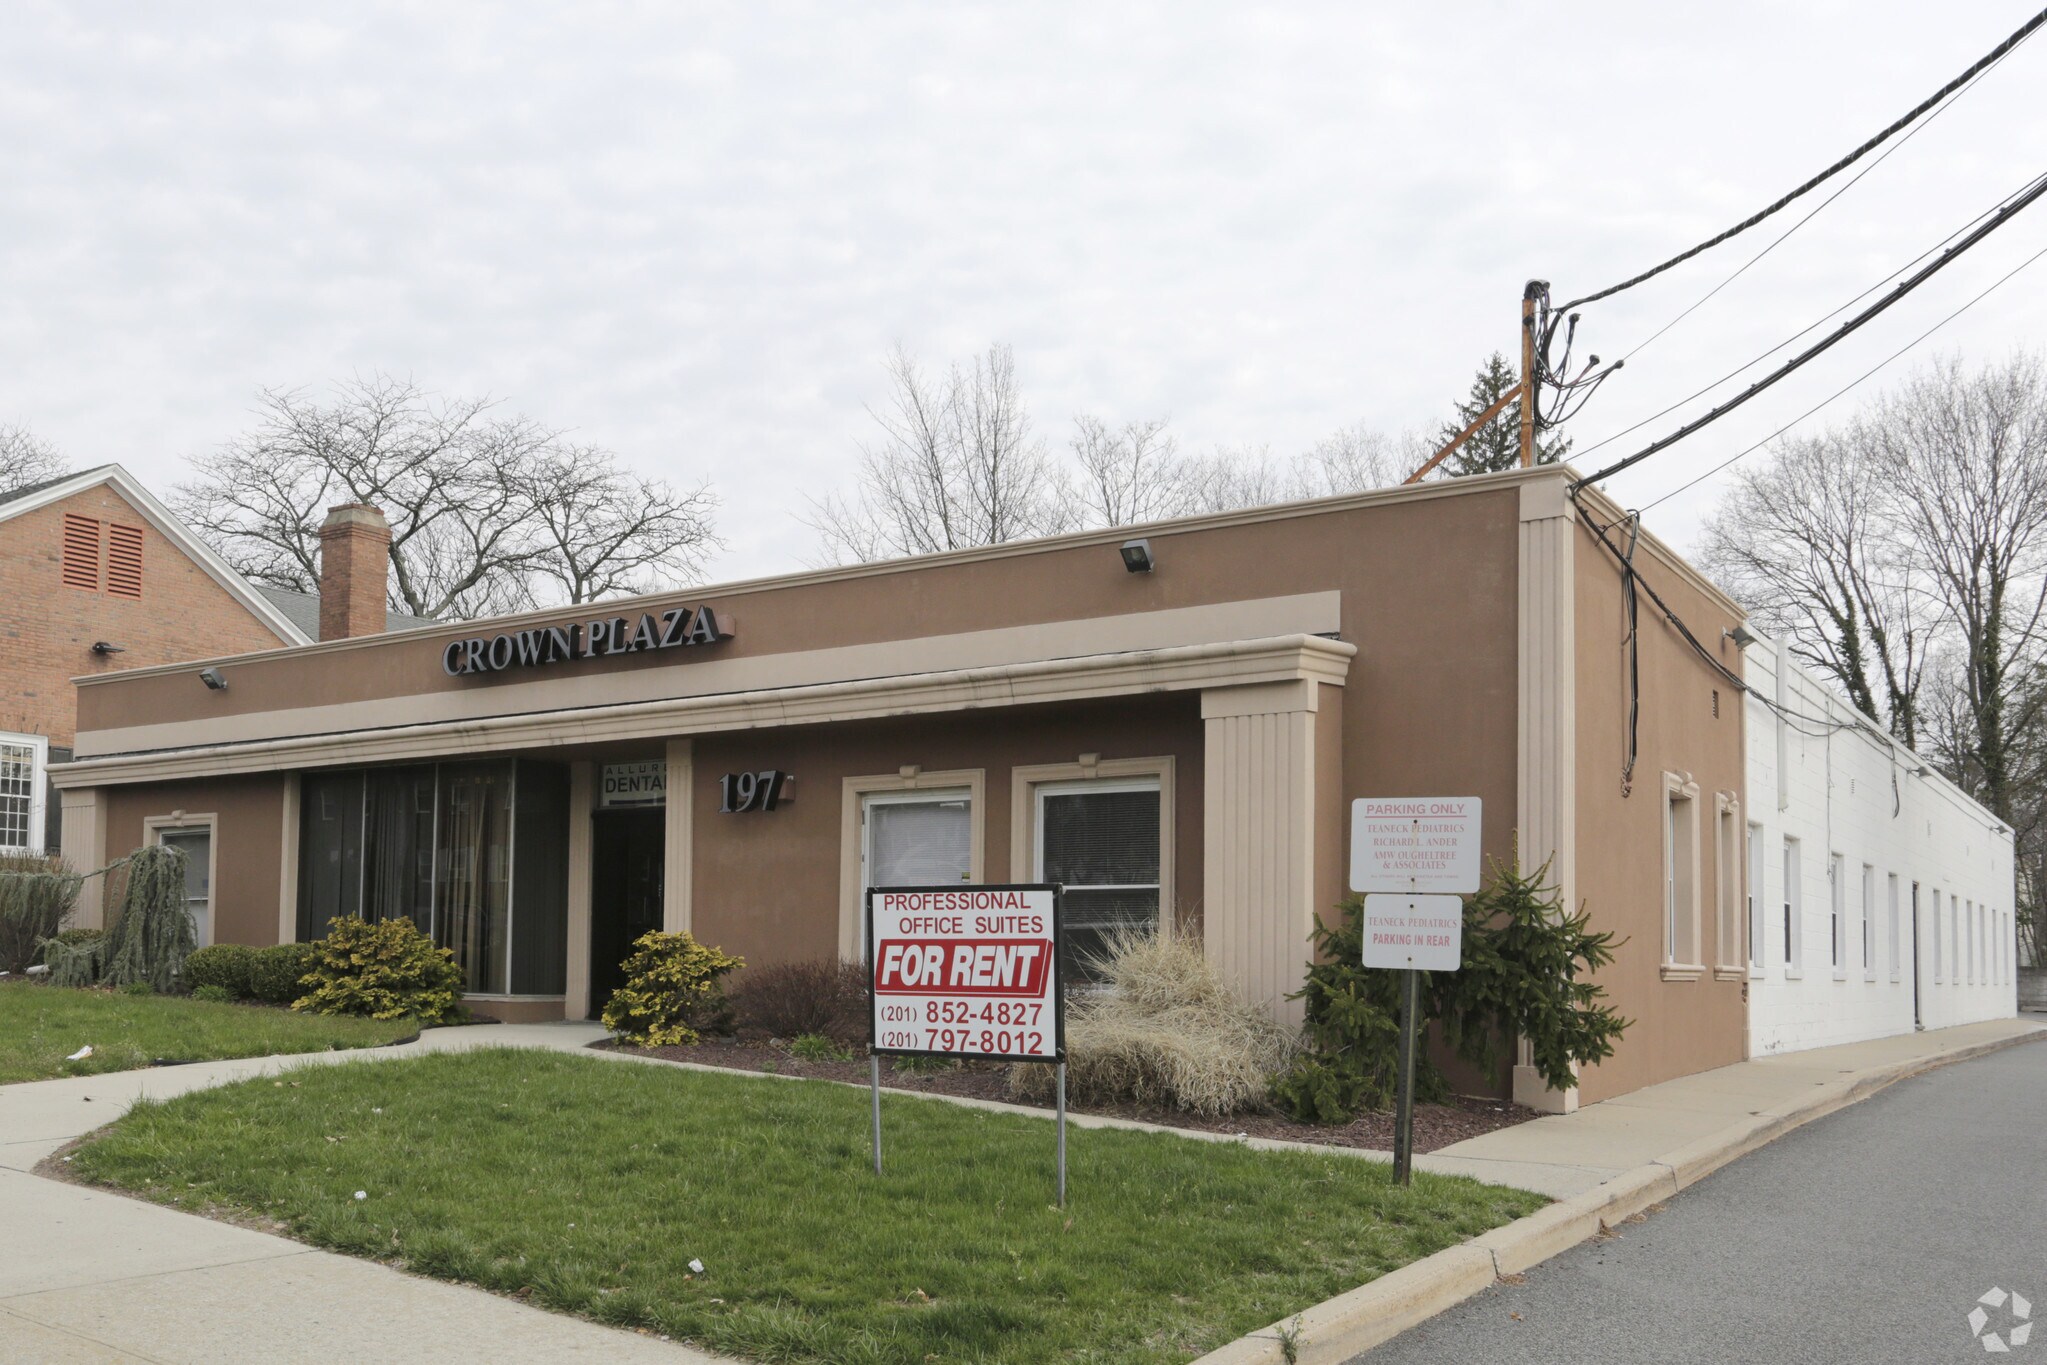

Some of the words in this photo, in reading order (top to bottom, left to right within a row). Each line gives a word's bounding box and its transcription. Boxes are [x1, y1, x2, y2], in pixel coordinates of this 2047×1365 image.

[442, 624, 582, 677] CROWN
[583, 605, 719, 657] PLAZA
[605, 775, 667, 793] DENTA
[719, 770, 782, 813] 197
[1366, 804, 1426, 814] PARKING
[1430, 803, 1465, 814] ONLY
[1368, 824, 1409, 833] TEANECK
[1411, 824, 1465, 833] PEDIATRICS
[1373, 838, 1414, 846] RICHARD
[1426, 838, 1457, 846] ANDER
[1374, 851, 1395, 860] AMW
[1383, 861, 1391, 869] &
[1394, 861, 1446, 870] ASSOCIATES
[884, 892, 1031, 911] PROFESSIONAL
[899, 917, 963, 934] OFFICE
[975, 915, 1043, 934] SUITES
[1368, 917, 1405, 927] TEANECK
[1408, 918, 1457, 928] PEDIATRICS
[1373, 933, 1411, 945] PARKING
[1414, 935, 1424, 946] IN
[1427, 935, 1450, 946] REAR
[881, 944, 945, 987] FOR
[950, 945, 1040, 988] RENT
[881, 1006, 917, 1022] (201)
[926, 1001, 1042, 1026] 852-4827
[881, 1031, 918, 1048] (201)
[925, 1028, 1042, 1055] 797-8012
